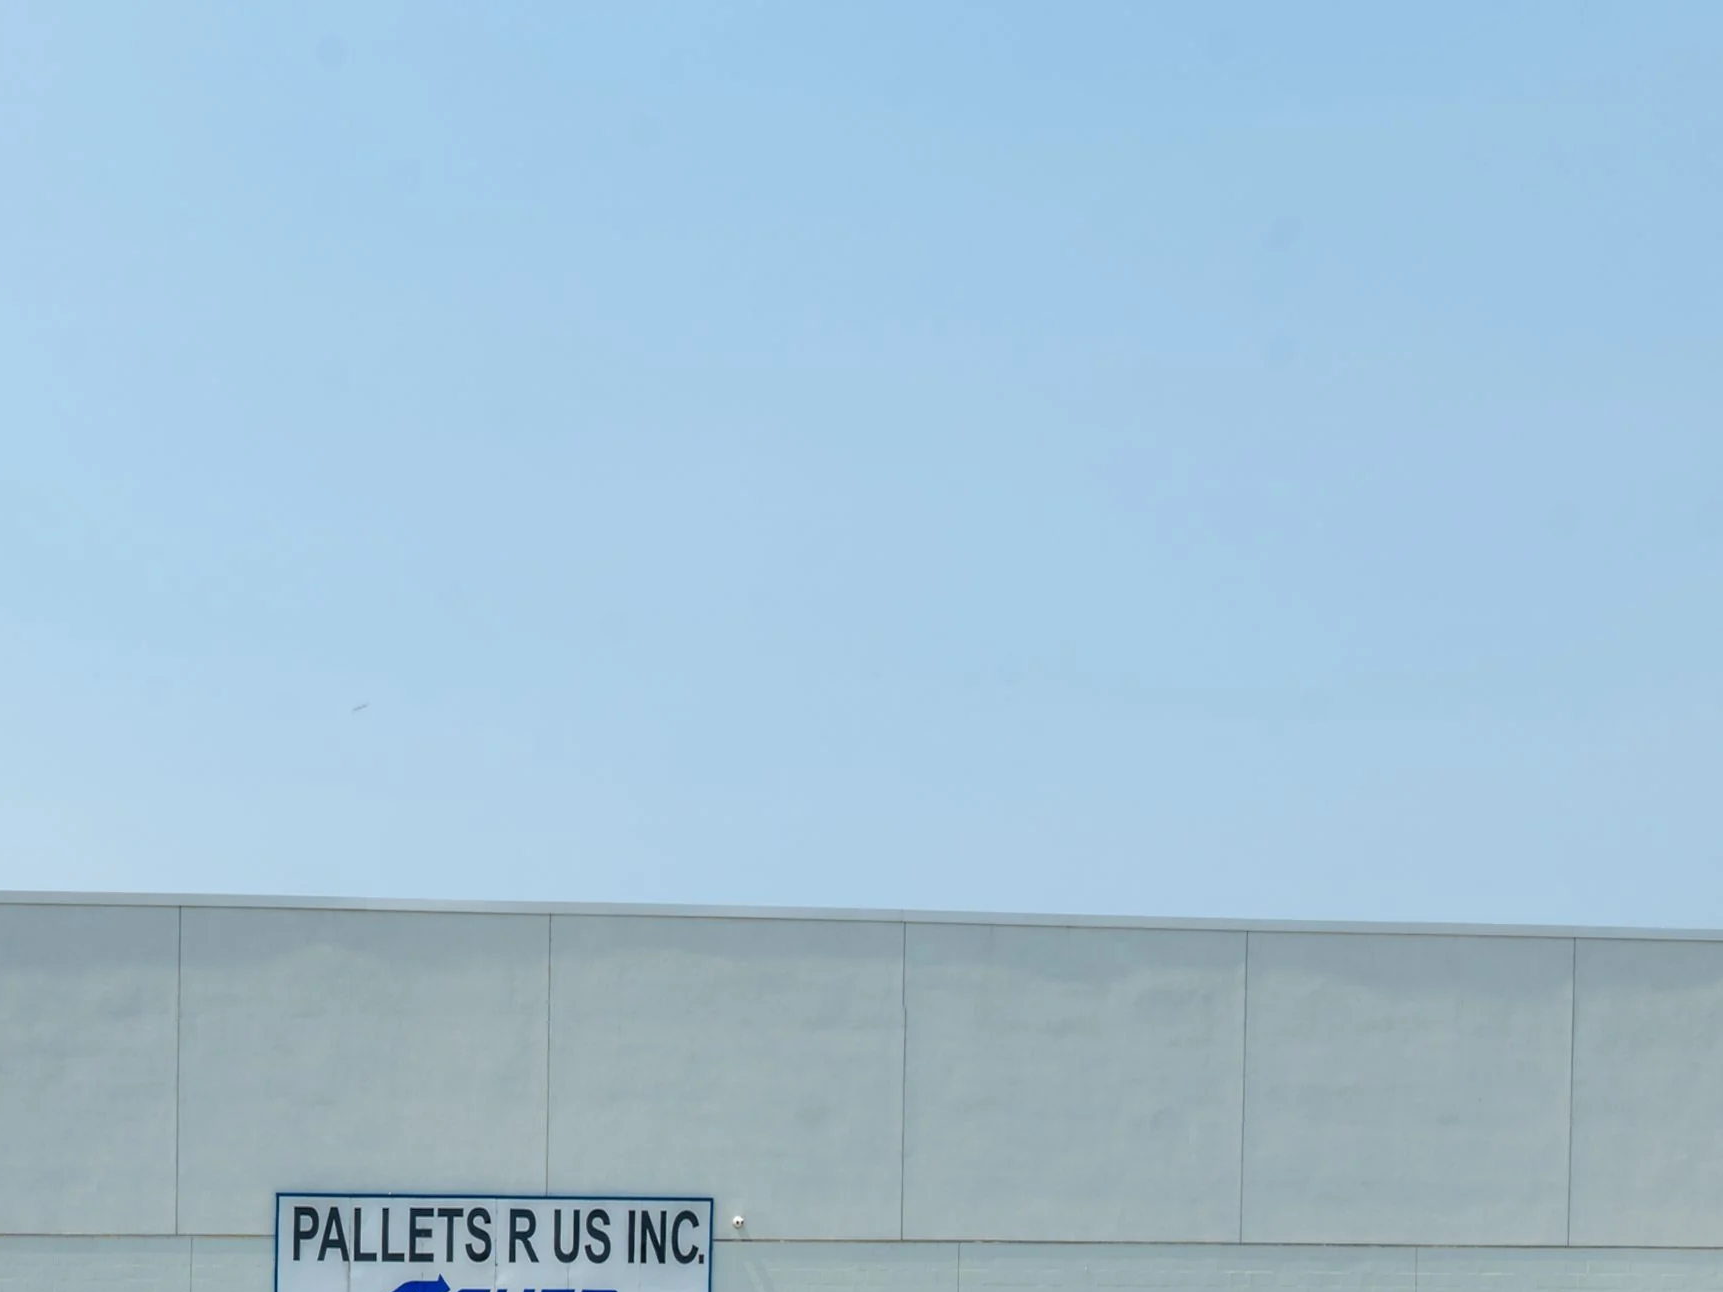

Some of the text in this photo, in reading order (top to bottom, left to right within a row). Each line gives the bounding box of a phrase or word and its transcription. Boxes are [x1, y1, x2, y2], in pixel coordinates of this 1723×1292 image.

[292, 1206, 705, 1265] PALLETS R US INC.
